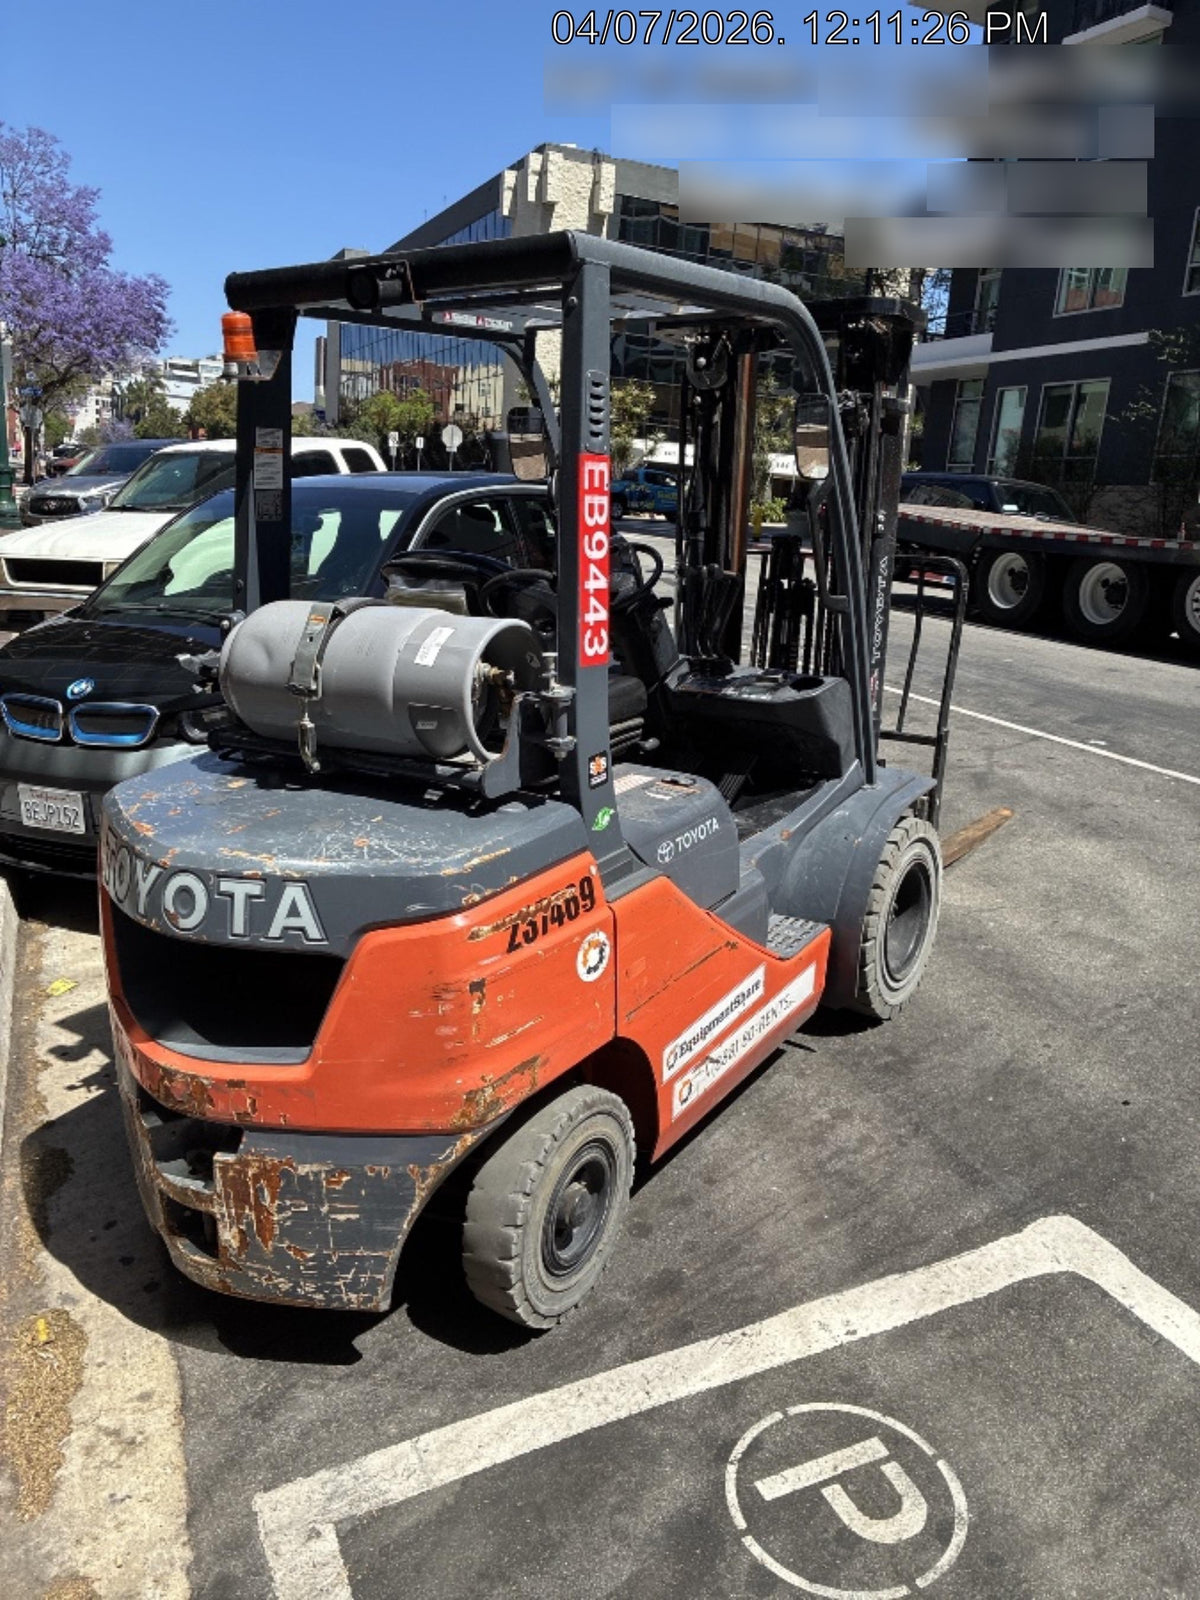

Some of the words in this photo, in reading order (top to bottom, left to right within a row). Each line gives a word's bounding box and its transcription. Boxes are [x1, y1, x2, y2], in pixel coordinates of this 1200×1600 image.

[583, 460, 609, 657] EB9443
[24, 801, 80, 829] 8EJP152
[675, 817, 720, 852] TOYOTA
[102, 827, 328, 944] TOYOTA
[678, 979, 761, 1058] EquipmentShare
[753, 1436, 928, 1544] P
